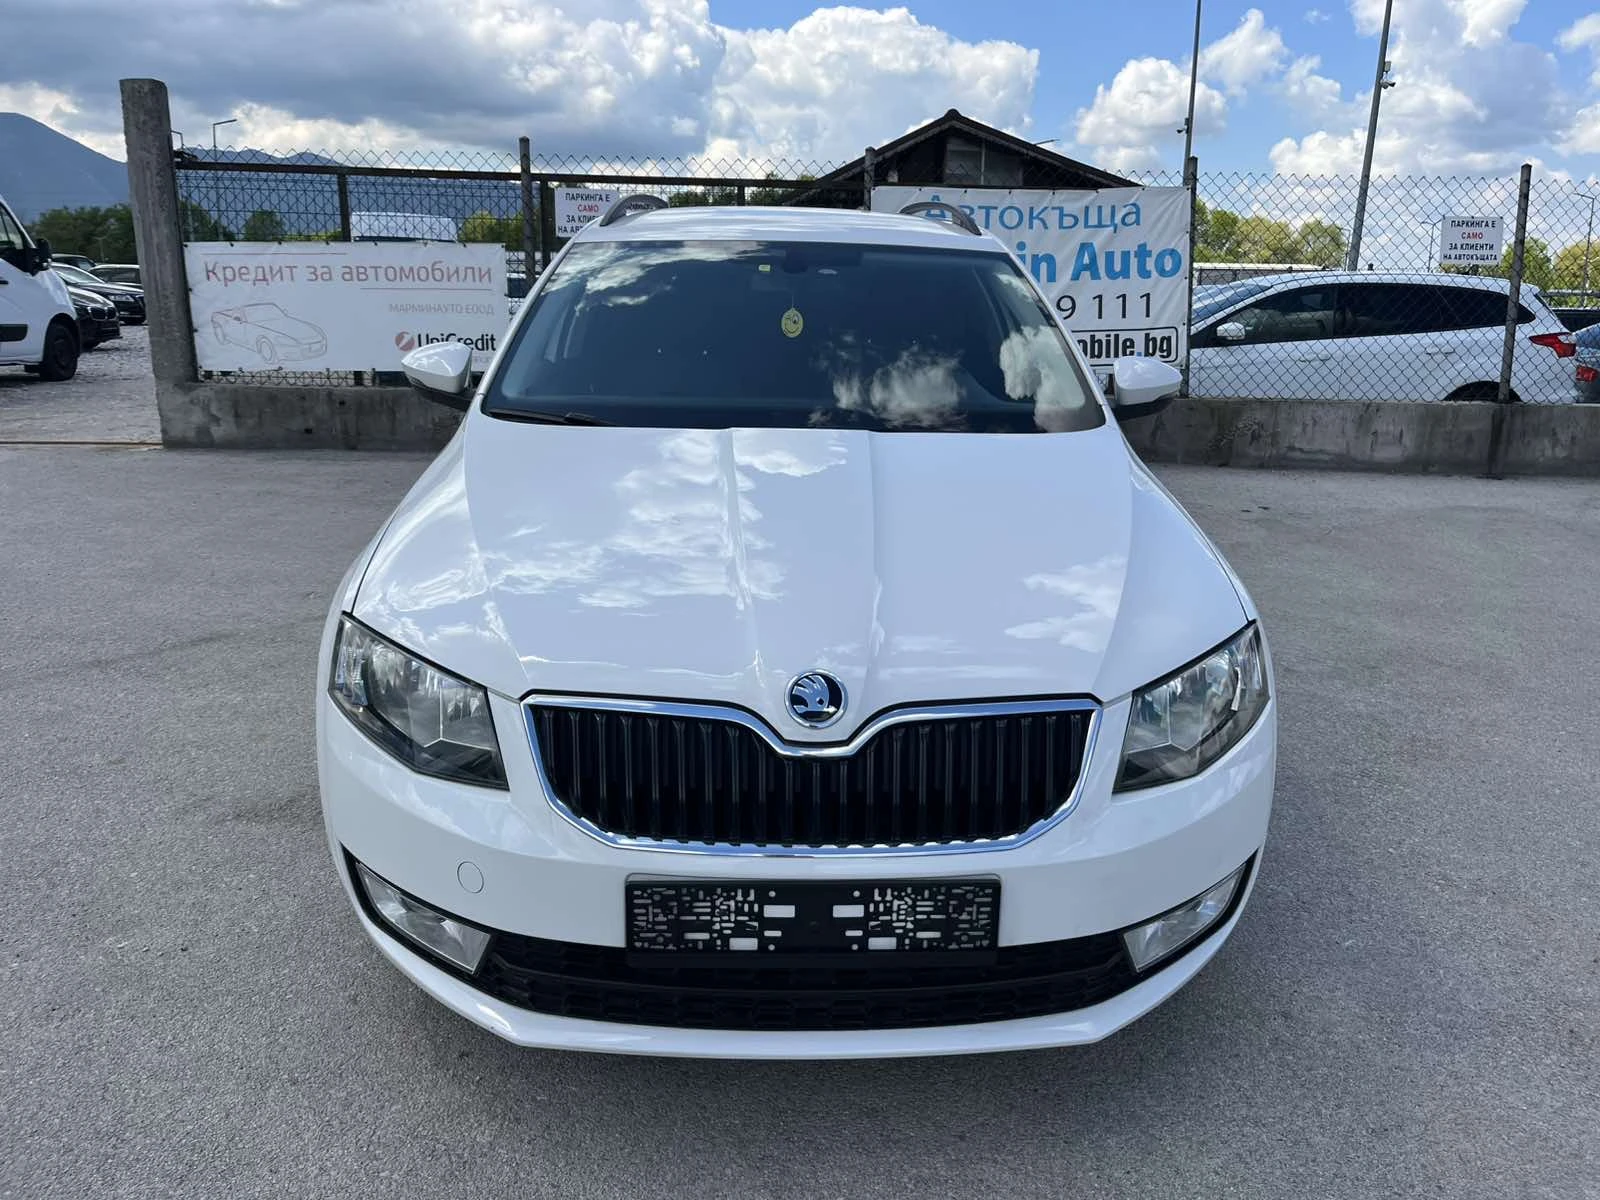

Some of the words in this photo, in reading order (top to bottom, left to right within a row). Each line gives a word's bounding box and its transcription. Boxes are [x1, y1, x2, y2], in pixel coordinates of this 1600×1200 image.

[565, 192, 604, 202] ПАРКИНГА
[605, 193, 611, 202] Е
[577, 203, 599, 213] САМО
[566, 214, 576, 224] ЗА
[1450, 219, 1490, 228] ПАРКИНГА
[1491, 220, 1496, 228] Е
[558, 225, 568, 234] НА
[1461, 231, 1483, 240] САМО
[1449, 242, 1458, 251] ЗА
[1460, 242, 1494, 251] КЛИЕНТИ
[1071, 241, 1182, 281] Auto
[1443, 253, 1453, 261] НА
[1454, 253, 1498, 262] АВТОКЪЩАТА
[204, 261, 298, 288] Кредит
[306, 264, 333, 282] за
[341, 260, 492, 283] автомобили
[464, 303, 495, 316] ЕООД
